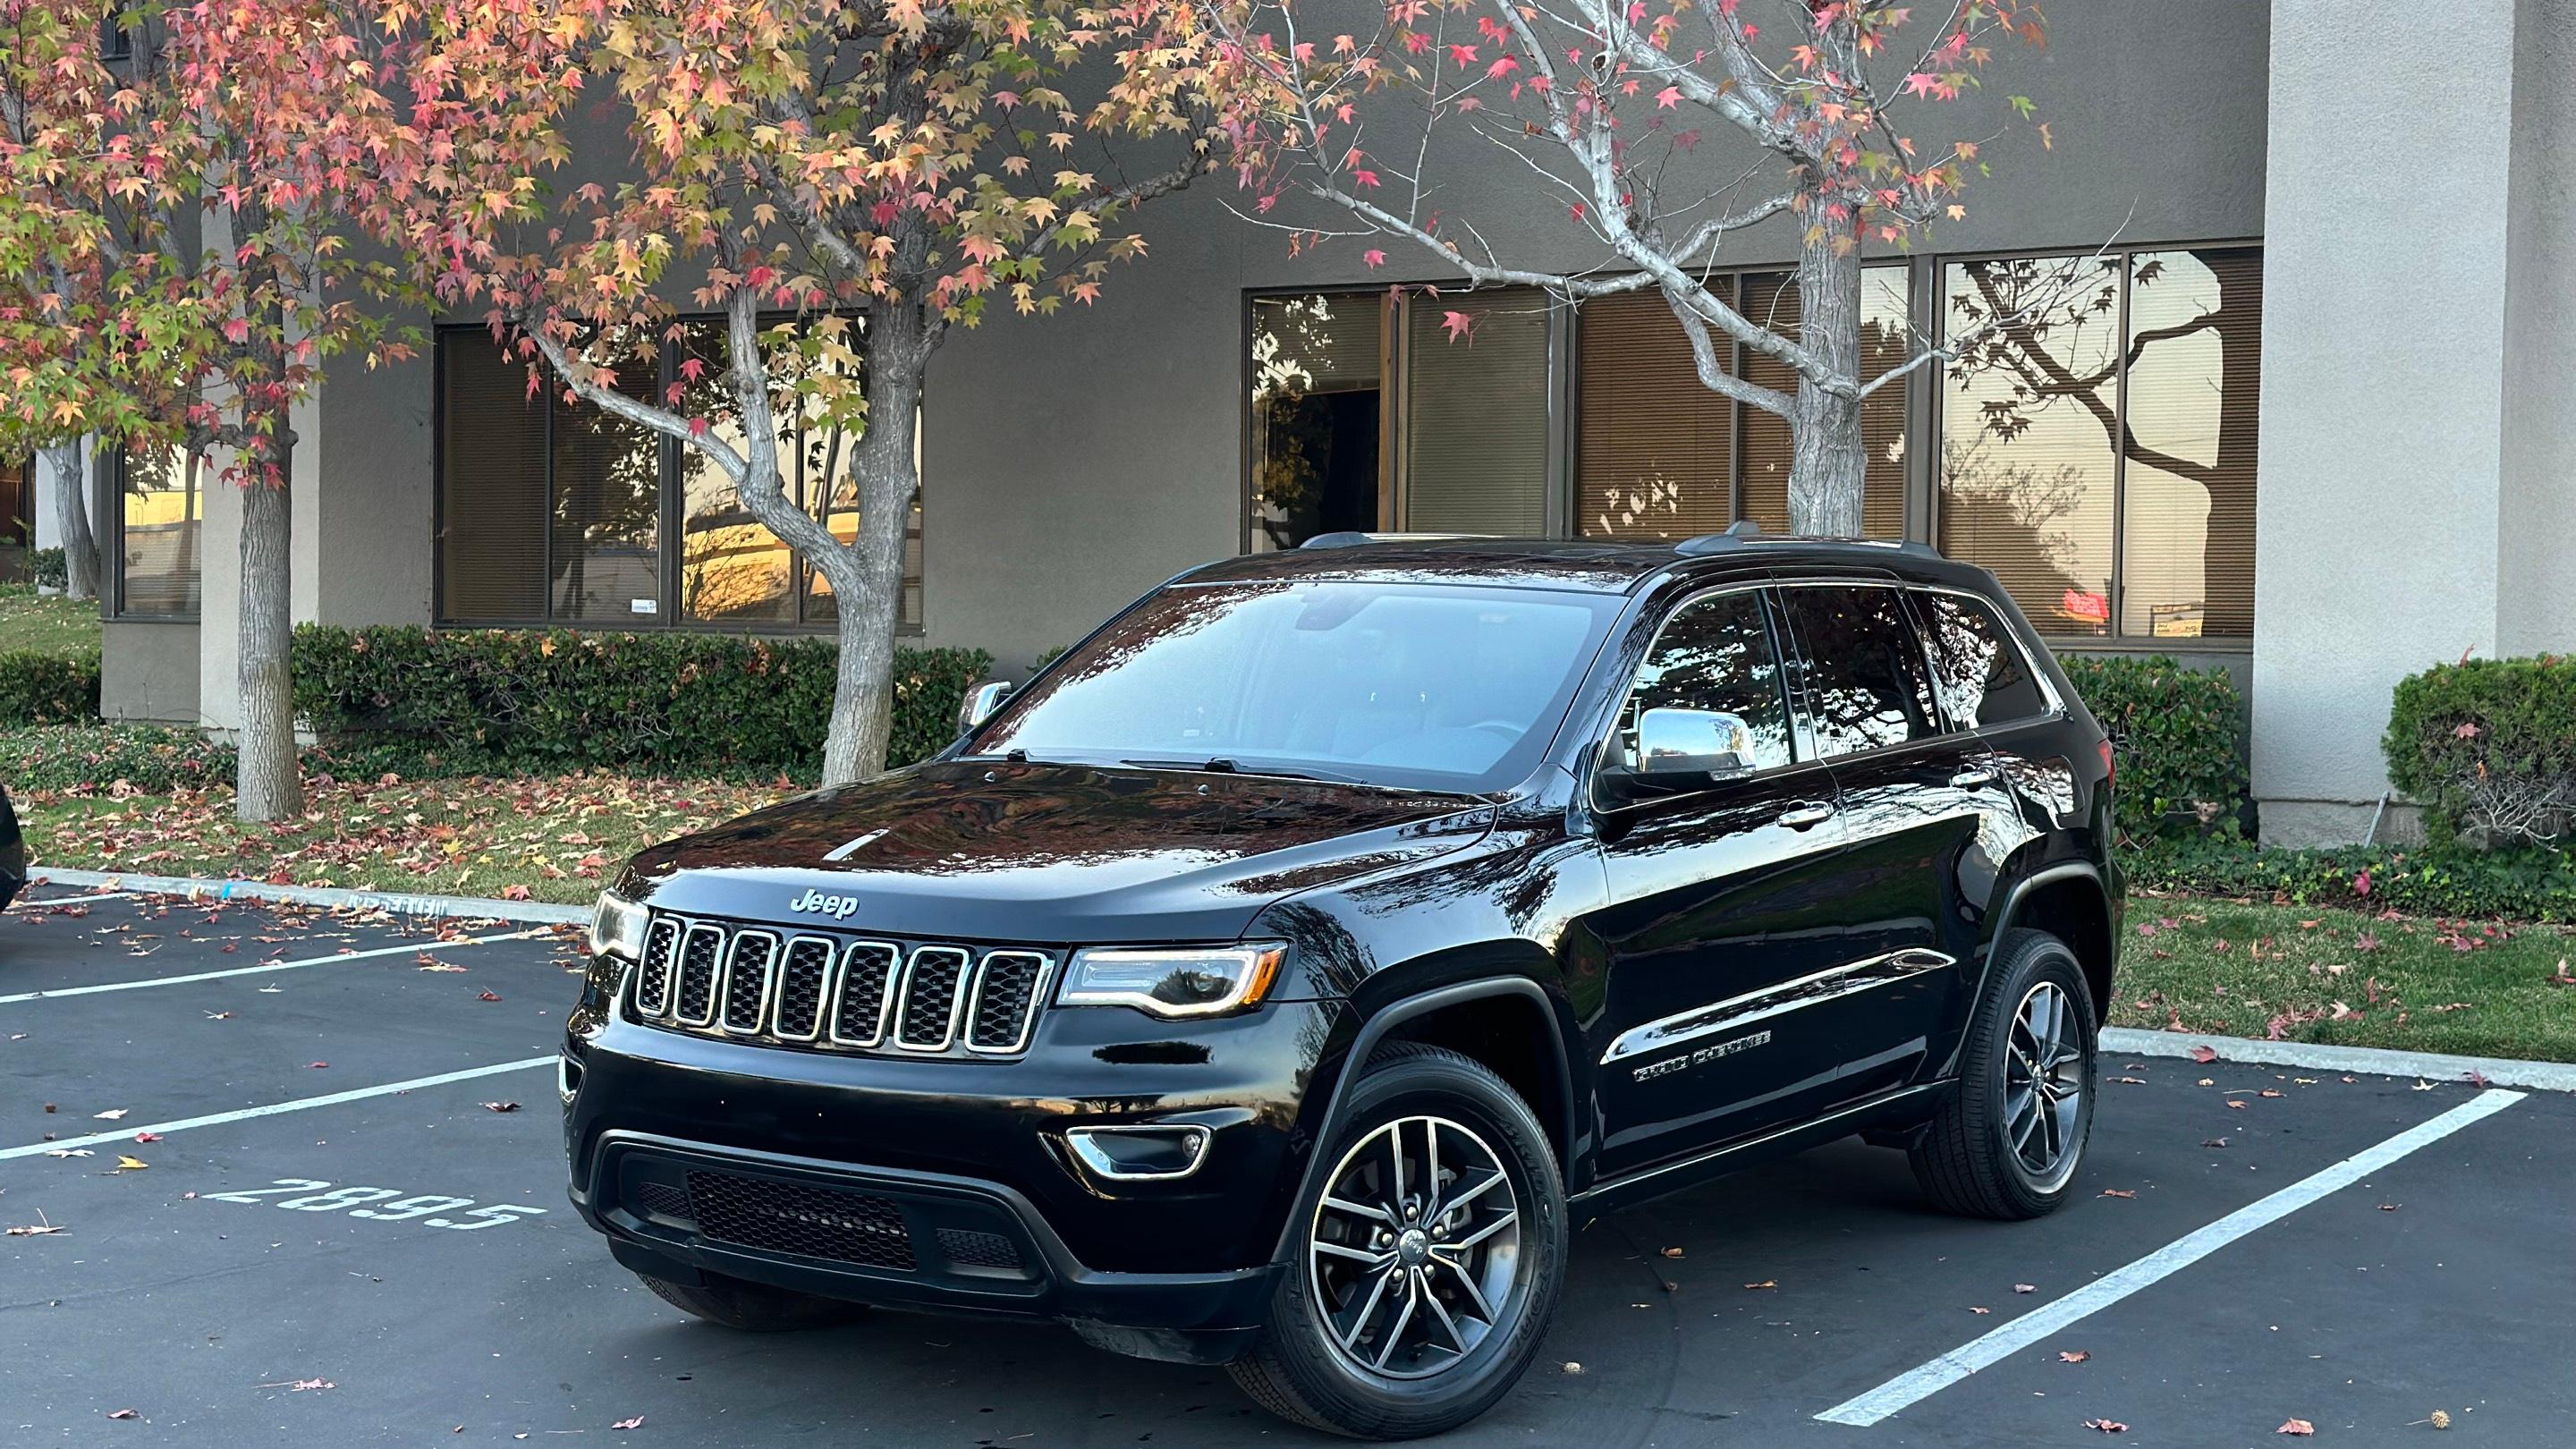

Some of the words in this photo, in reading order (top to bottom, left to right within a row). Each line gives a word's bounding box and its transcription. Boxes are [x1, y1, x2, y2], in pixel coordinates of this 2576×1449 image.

[791, 888, 859, 920] Jeep
[1632, 1055, 1689, 1082] GRAND
[1693, 1030, 1771, 1063] CHEROKEE
[202, 1179, 547, 1229] 2895
